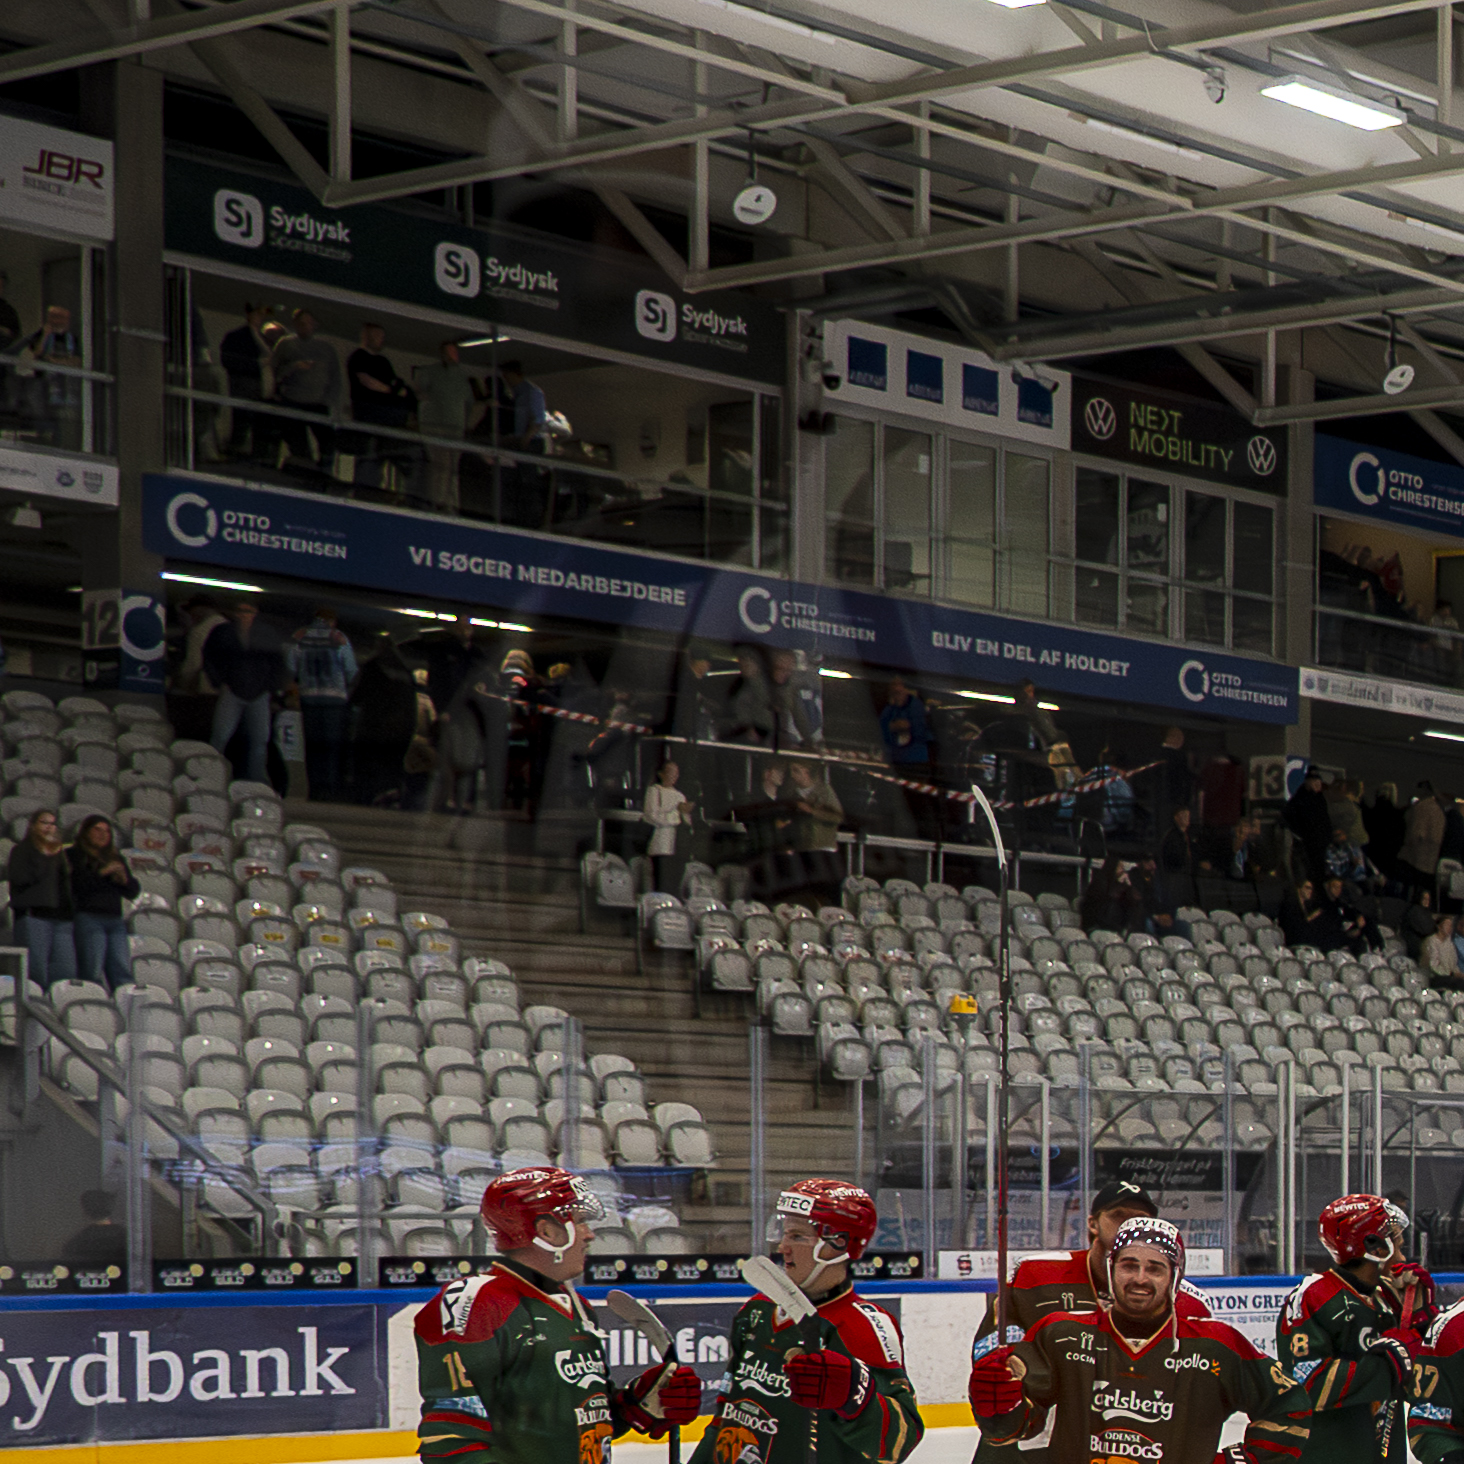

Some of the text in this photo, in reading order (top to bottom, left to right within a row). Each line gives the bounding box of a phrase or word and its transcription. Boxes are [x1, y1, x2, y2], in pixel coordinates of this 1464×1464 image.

[23, 149, 104, 190] JBR
[269, 206, 351, 244] Sydjysk
[485, 257, 560, 292] Sydjysk
[682, 303, 748, 336] Sydjysk
[1129, 427, 1234, 472] MOBILITY
[1389, 469, 1424, 490] OTTO
[222, 509, 271, 531] OTTO
[222, 527, 347, 560] CHRESTENSEN
[409, 546, 687, 607] VI SØGER MEDARBEJDERE
[932, 631, 1131, 677] BLIV EN DEL AF HOLDET
[1164, 1353, 1210, 1373] apollo
[1090, 1433, 1164, 1460] BULLDOGS
[1104, 1430, 1141, 1443] ODENSE
